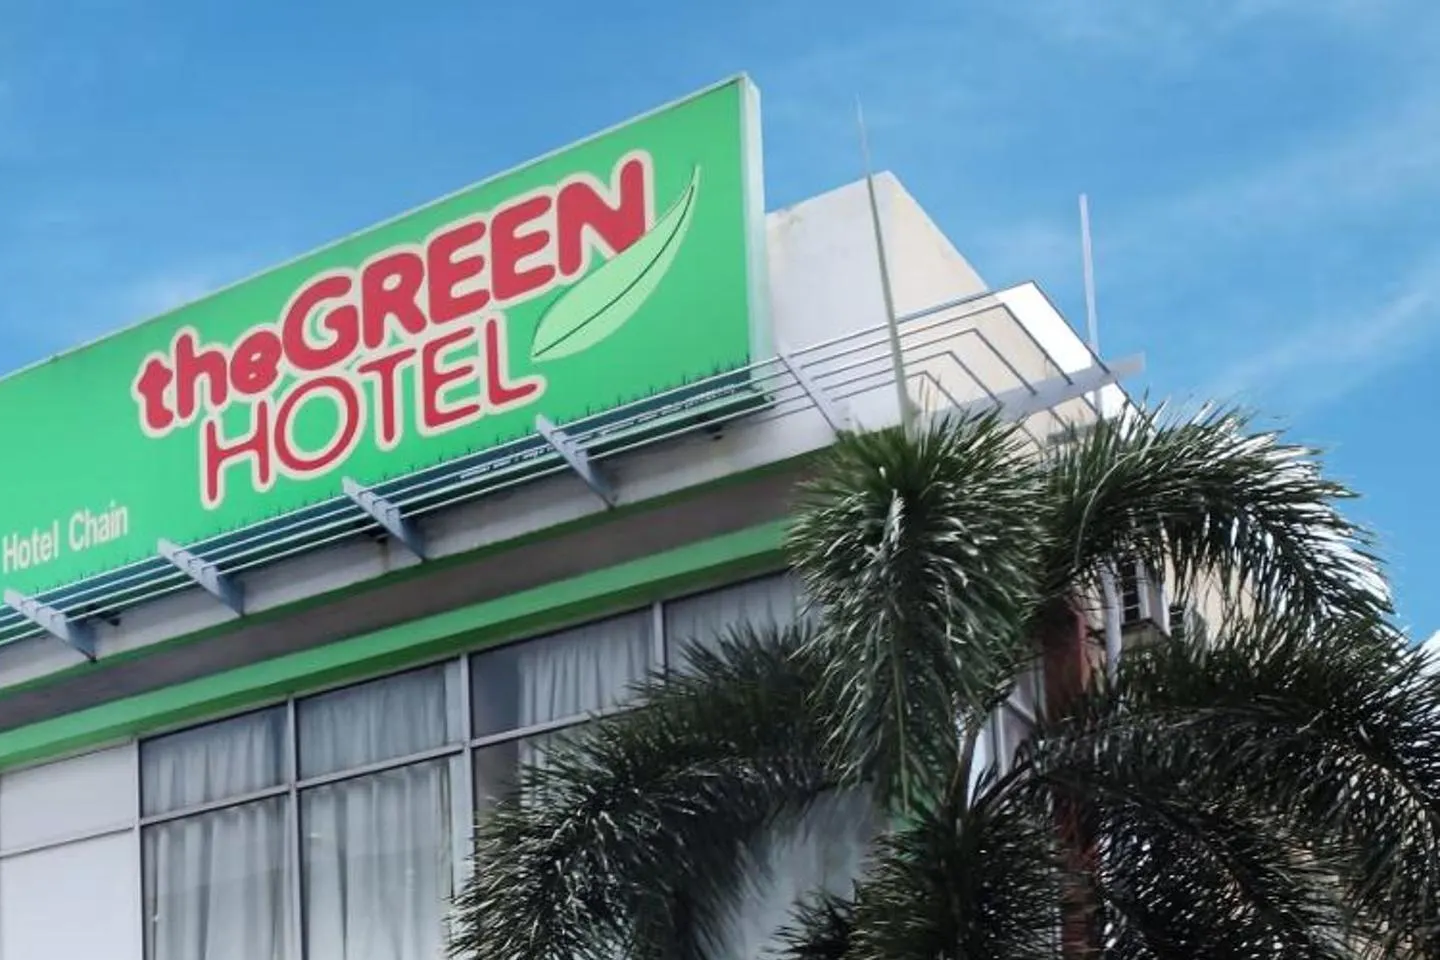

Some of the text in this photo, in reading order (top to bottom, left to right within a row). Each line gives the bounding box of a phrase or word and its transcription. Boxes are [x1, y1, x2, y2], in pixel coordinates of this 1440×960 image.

[202, 315, 541, 506] HOTEL
[2, 518, 60, 574] Hotel
[68, 499, 128, 551] Chain
